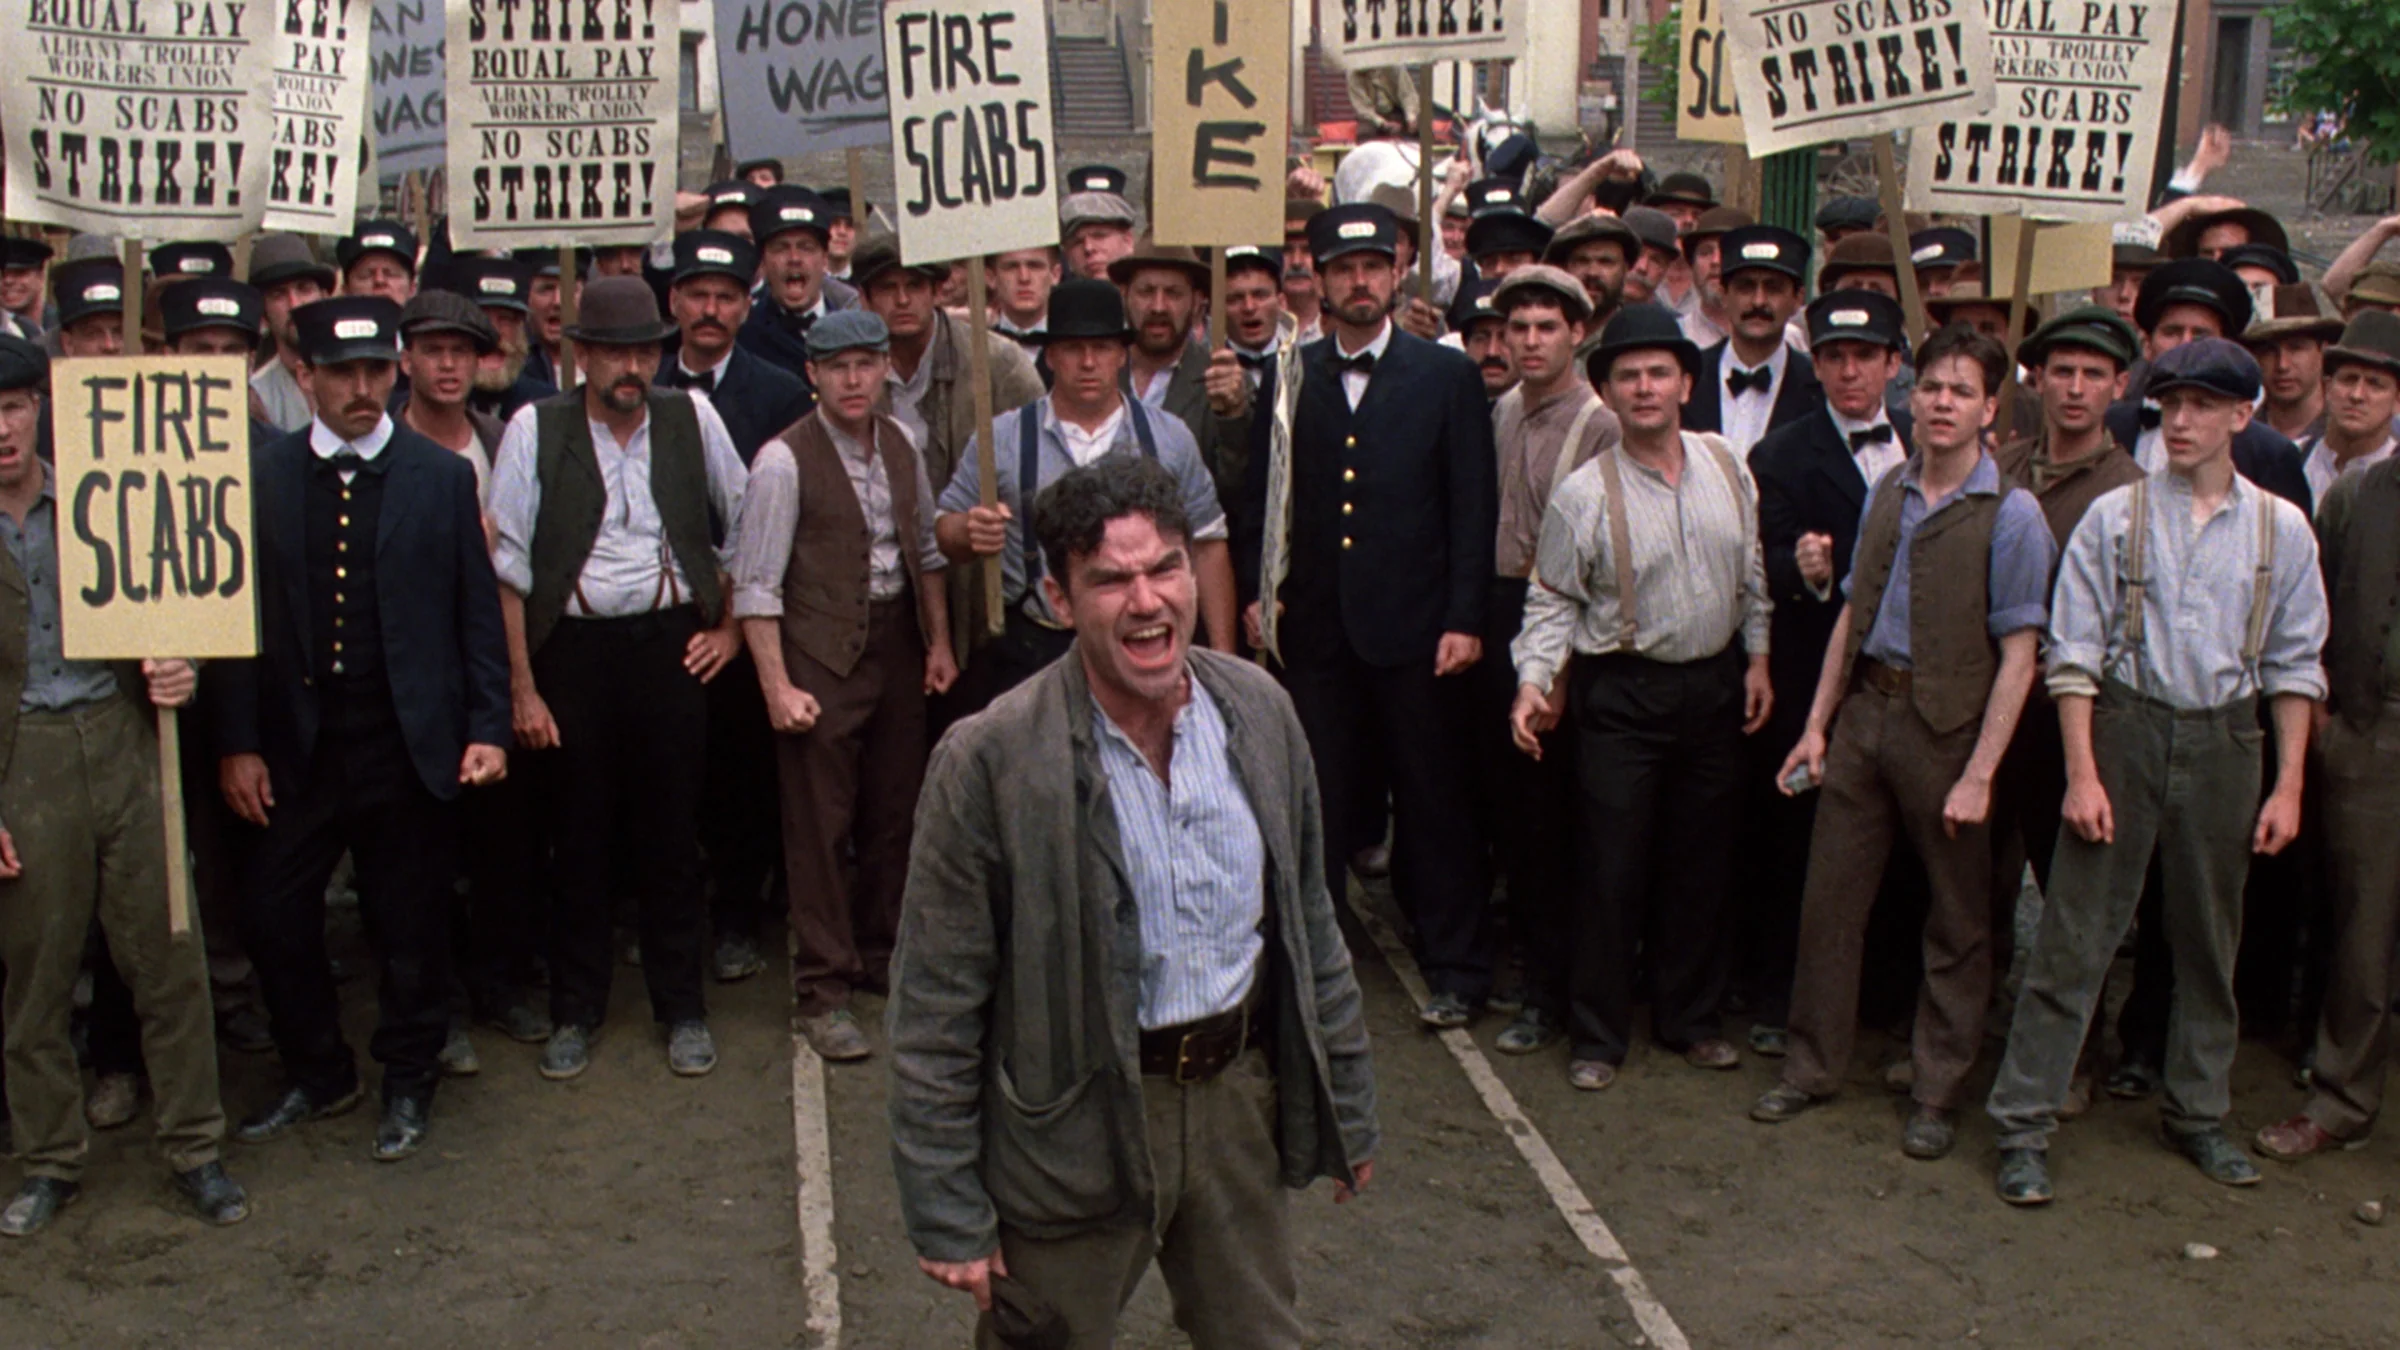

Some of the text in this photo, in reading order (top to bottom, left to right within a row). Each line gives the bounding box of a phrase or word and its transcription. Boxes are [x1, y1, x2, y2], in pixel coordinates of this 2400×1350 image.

[29, 0, 245, 37] EQUAL PAY
[469, 0, 655, 41] STRIKE!
[736, 0, 876, 53] HONE
[1343, 0, 1503, 42] STRIKE!
[1762, 11, 1808, 49] NO
[1834, 0, 1952, 36] SCABS
[1994, 0, 2149, 36] UAL PAY
[37, 35, 242, 66] ALBANY TROLLEY
[48, 55, 234, 86] WORKERS UNION
[293, 42, 346, 75] PAY
[472, 46, 655, 79] EQUAL PAY
[895, 10, 1021, 99] FIRE
[1761, 22, 1967, 118] STRIKE!
[1990, 38, 2140, 63] ANY TROLLEY
[1993, 57, 2129, 81] RKERS UNION
[275, 75, 341, 96] ROLLEY
[479, 83, 651, 104] ALBANY TROLLEY
[767, 53, 886, 113] WAG
[1186, 0, 1267, 191] IKE
[37, 87, 239, 132] NO SCABS
[488, 101, 645, 121] WORKERS UNION
[2019, 86, 2132, 124] SCABS
[272, 115, 337, 148] ABS
[481, 126, 651, 160] NO SCABS
[30, 129, 244, 206] STRIKE!
[903, 100, 1046, 216] SCABS
[1934, 122, 2133, 192] STRIKE!
[473, 162, 655, 221] STRIKE!
[82, 370, 232, 461] FIRE
[72, 468, 245, 608] SCABS
